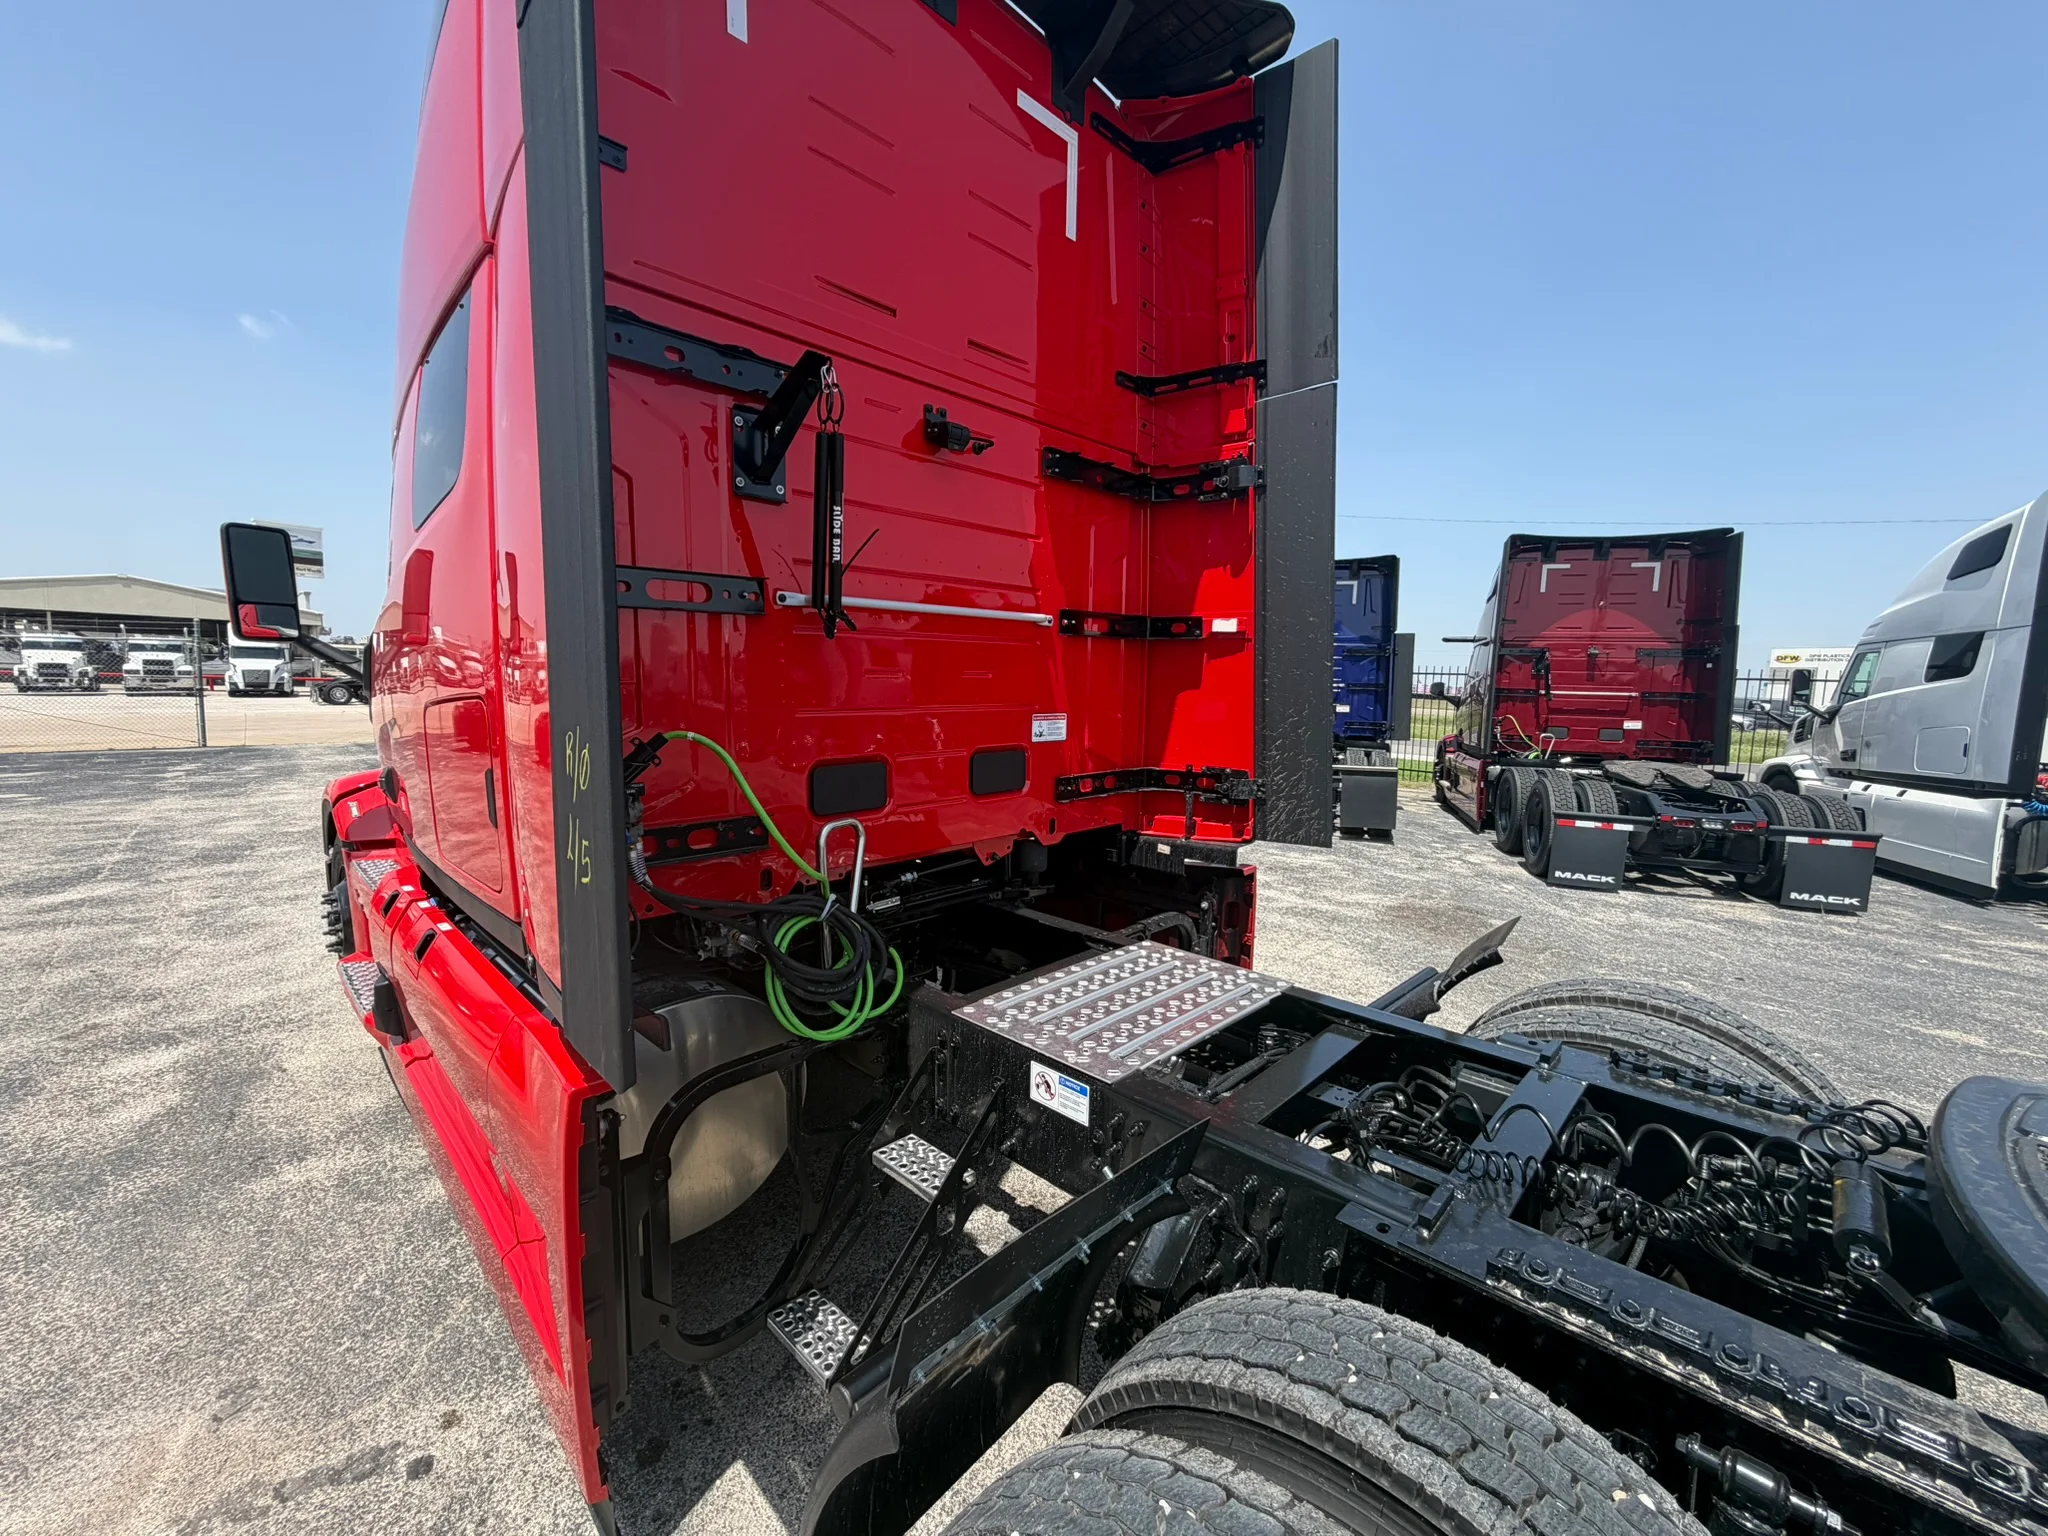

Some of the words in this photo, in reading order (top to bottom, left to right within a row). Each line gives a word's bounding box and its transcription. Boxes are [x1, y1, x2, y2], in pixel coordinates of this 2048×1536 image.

[832, 505, 844, 535] SLYDE
[1554, 870, 1616, 884] MACK
[1789, 891, 1862, 906] MACK
[1065, 1080, 1081, 1092] NOTICE
